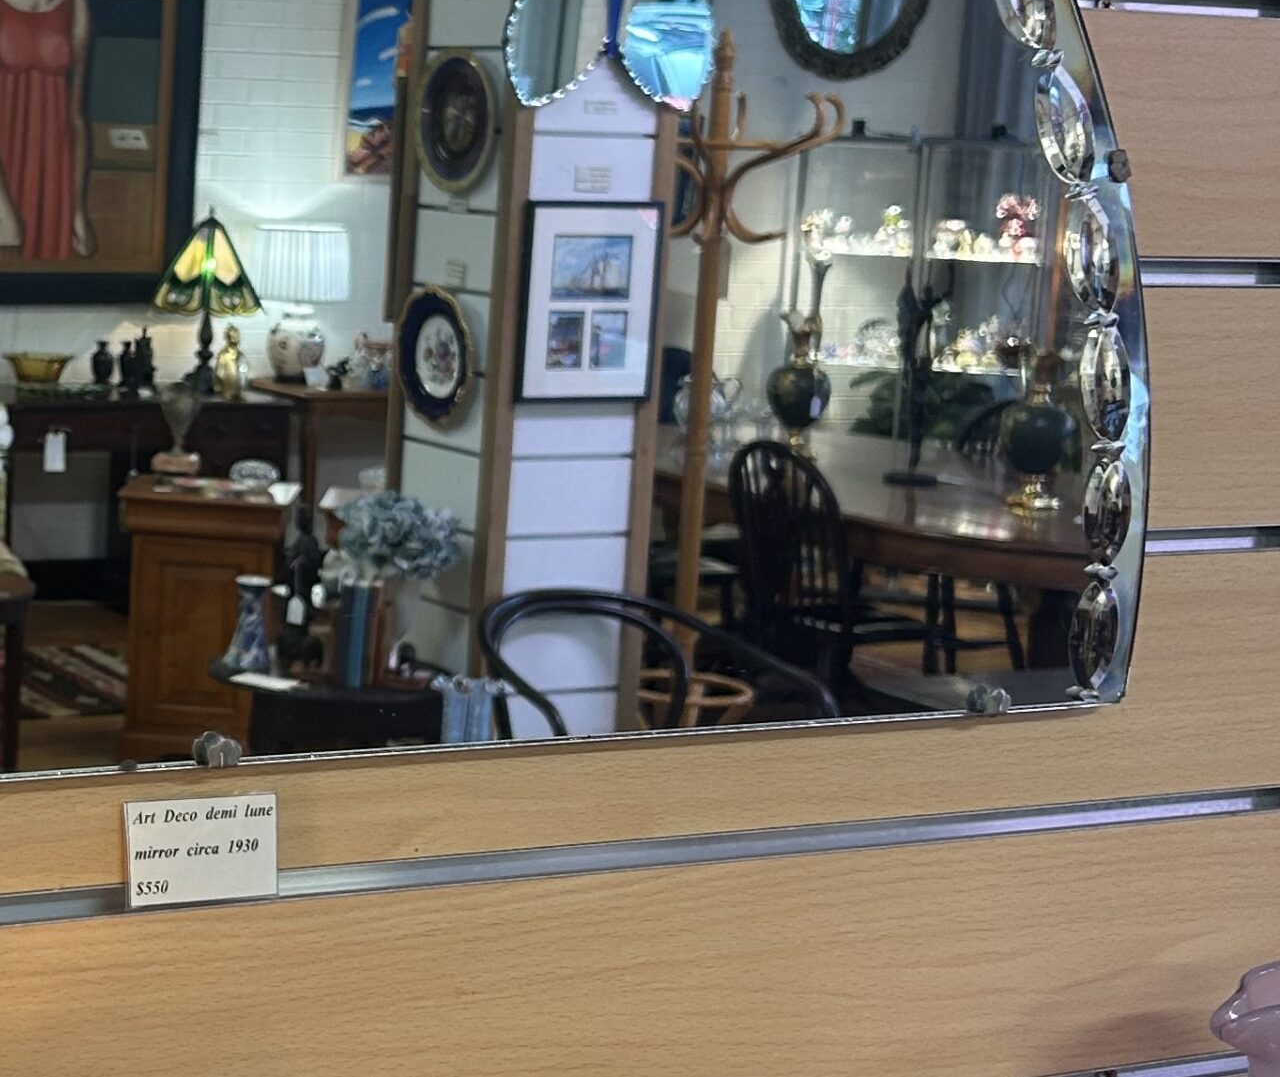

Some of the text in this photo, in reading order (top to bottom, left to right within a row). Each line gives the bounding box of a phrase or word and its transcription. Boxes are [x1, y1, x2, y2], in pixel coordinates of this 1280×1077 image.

[133, 804, 273, 824] Art Deco demi lune
[135, 838, 258, 860] mirror circa 1930
[136, 880, 169, 896] $550
